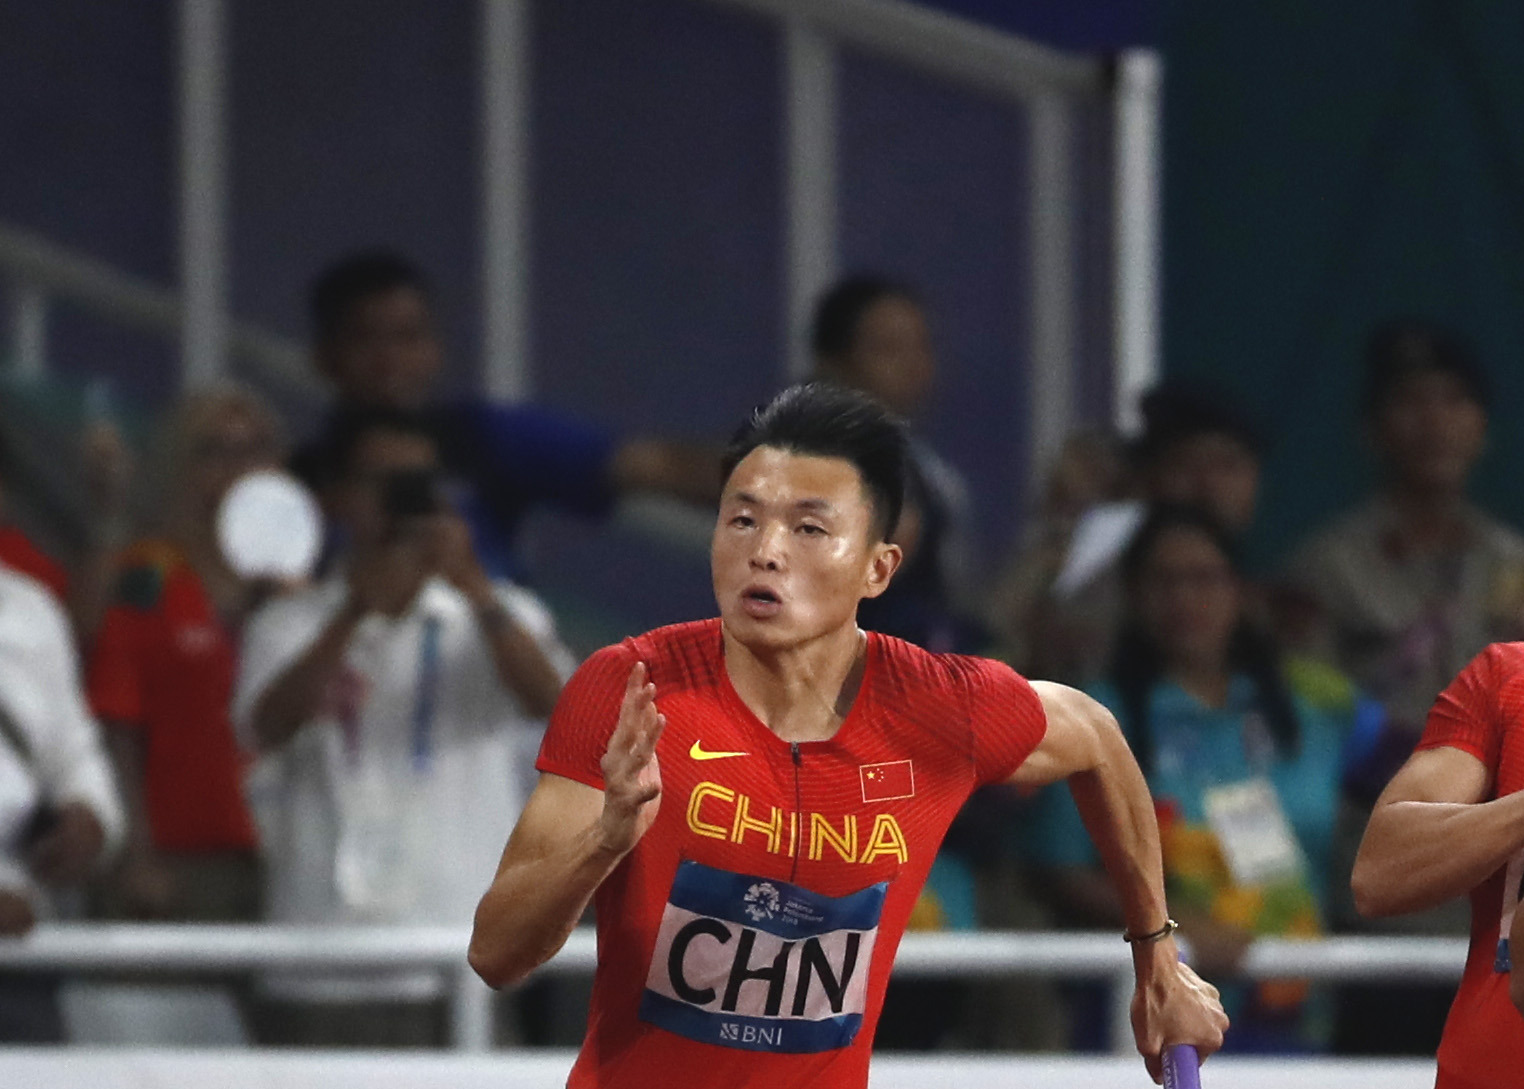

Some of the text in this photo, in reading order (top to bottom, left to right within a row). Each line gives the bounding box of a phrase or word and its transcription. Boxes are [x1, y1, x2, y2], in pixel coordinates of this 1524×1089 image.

[686, 781, 909, 864] CHINA
[667, 917, 861, 1017] CHN
[741, 1023, 783, 1046] BNI
